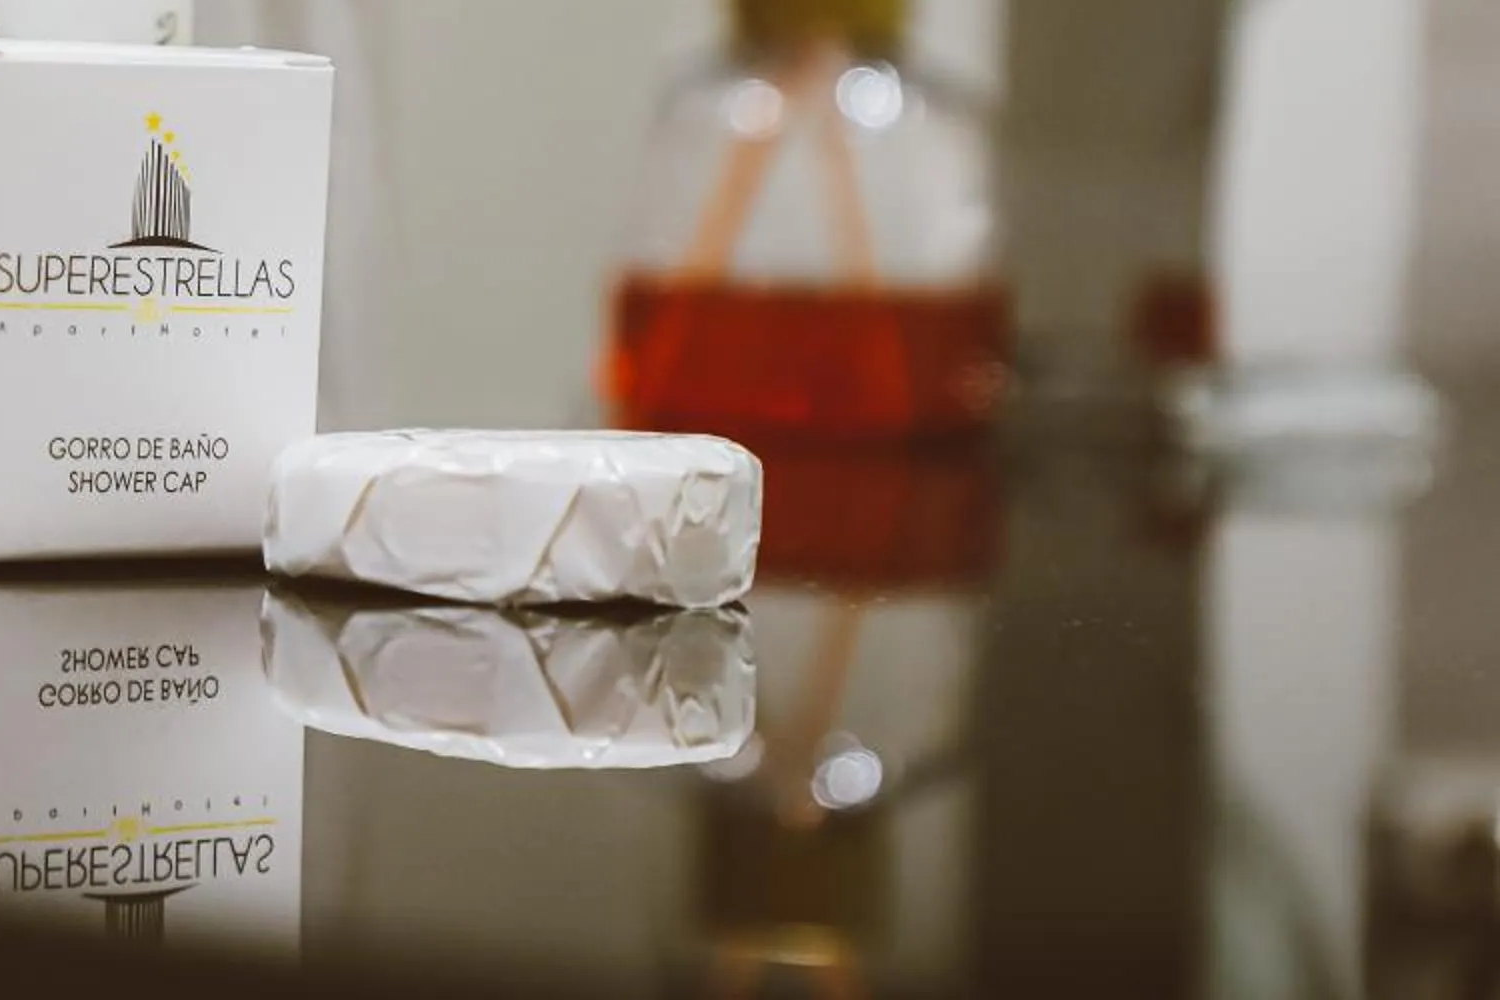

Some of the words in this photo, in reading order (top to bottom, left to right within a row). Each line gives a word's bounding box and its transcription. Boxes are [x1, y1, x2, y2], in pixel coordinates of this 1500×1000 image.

[49, 437, 131, 460] GORRO
[136, 437, 164, 460] DE
[168, 433, 229, 460] BAÑO
[67, 471, 157, 494] SHOWER
[163, 471, 207, 493] CAP
